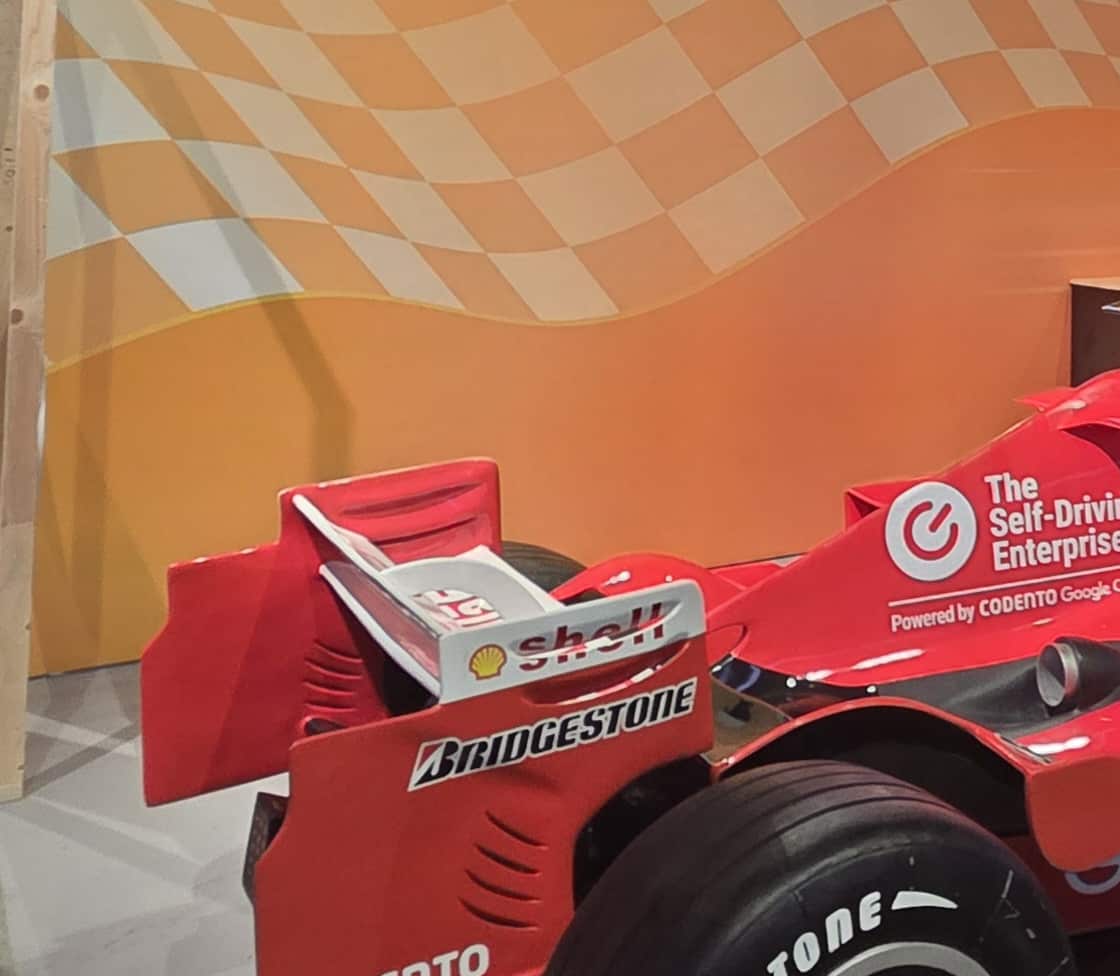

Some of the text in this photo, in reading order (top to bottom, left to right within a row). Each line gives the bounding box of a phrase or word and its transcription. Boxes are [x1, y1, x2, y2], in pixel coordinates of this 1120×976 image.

[984, 472, 1038, 503] The
[891, 604, 954, 632] Powered
[957, 602, 975, 624] by
[979, 589, 1058, 617] CODENTO
[1061, 581, 1112, 602] Google
[410, 678, 697, 790] BRIDGESTONE
